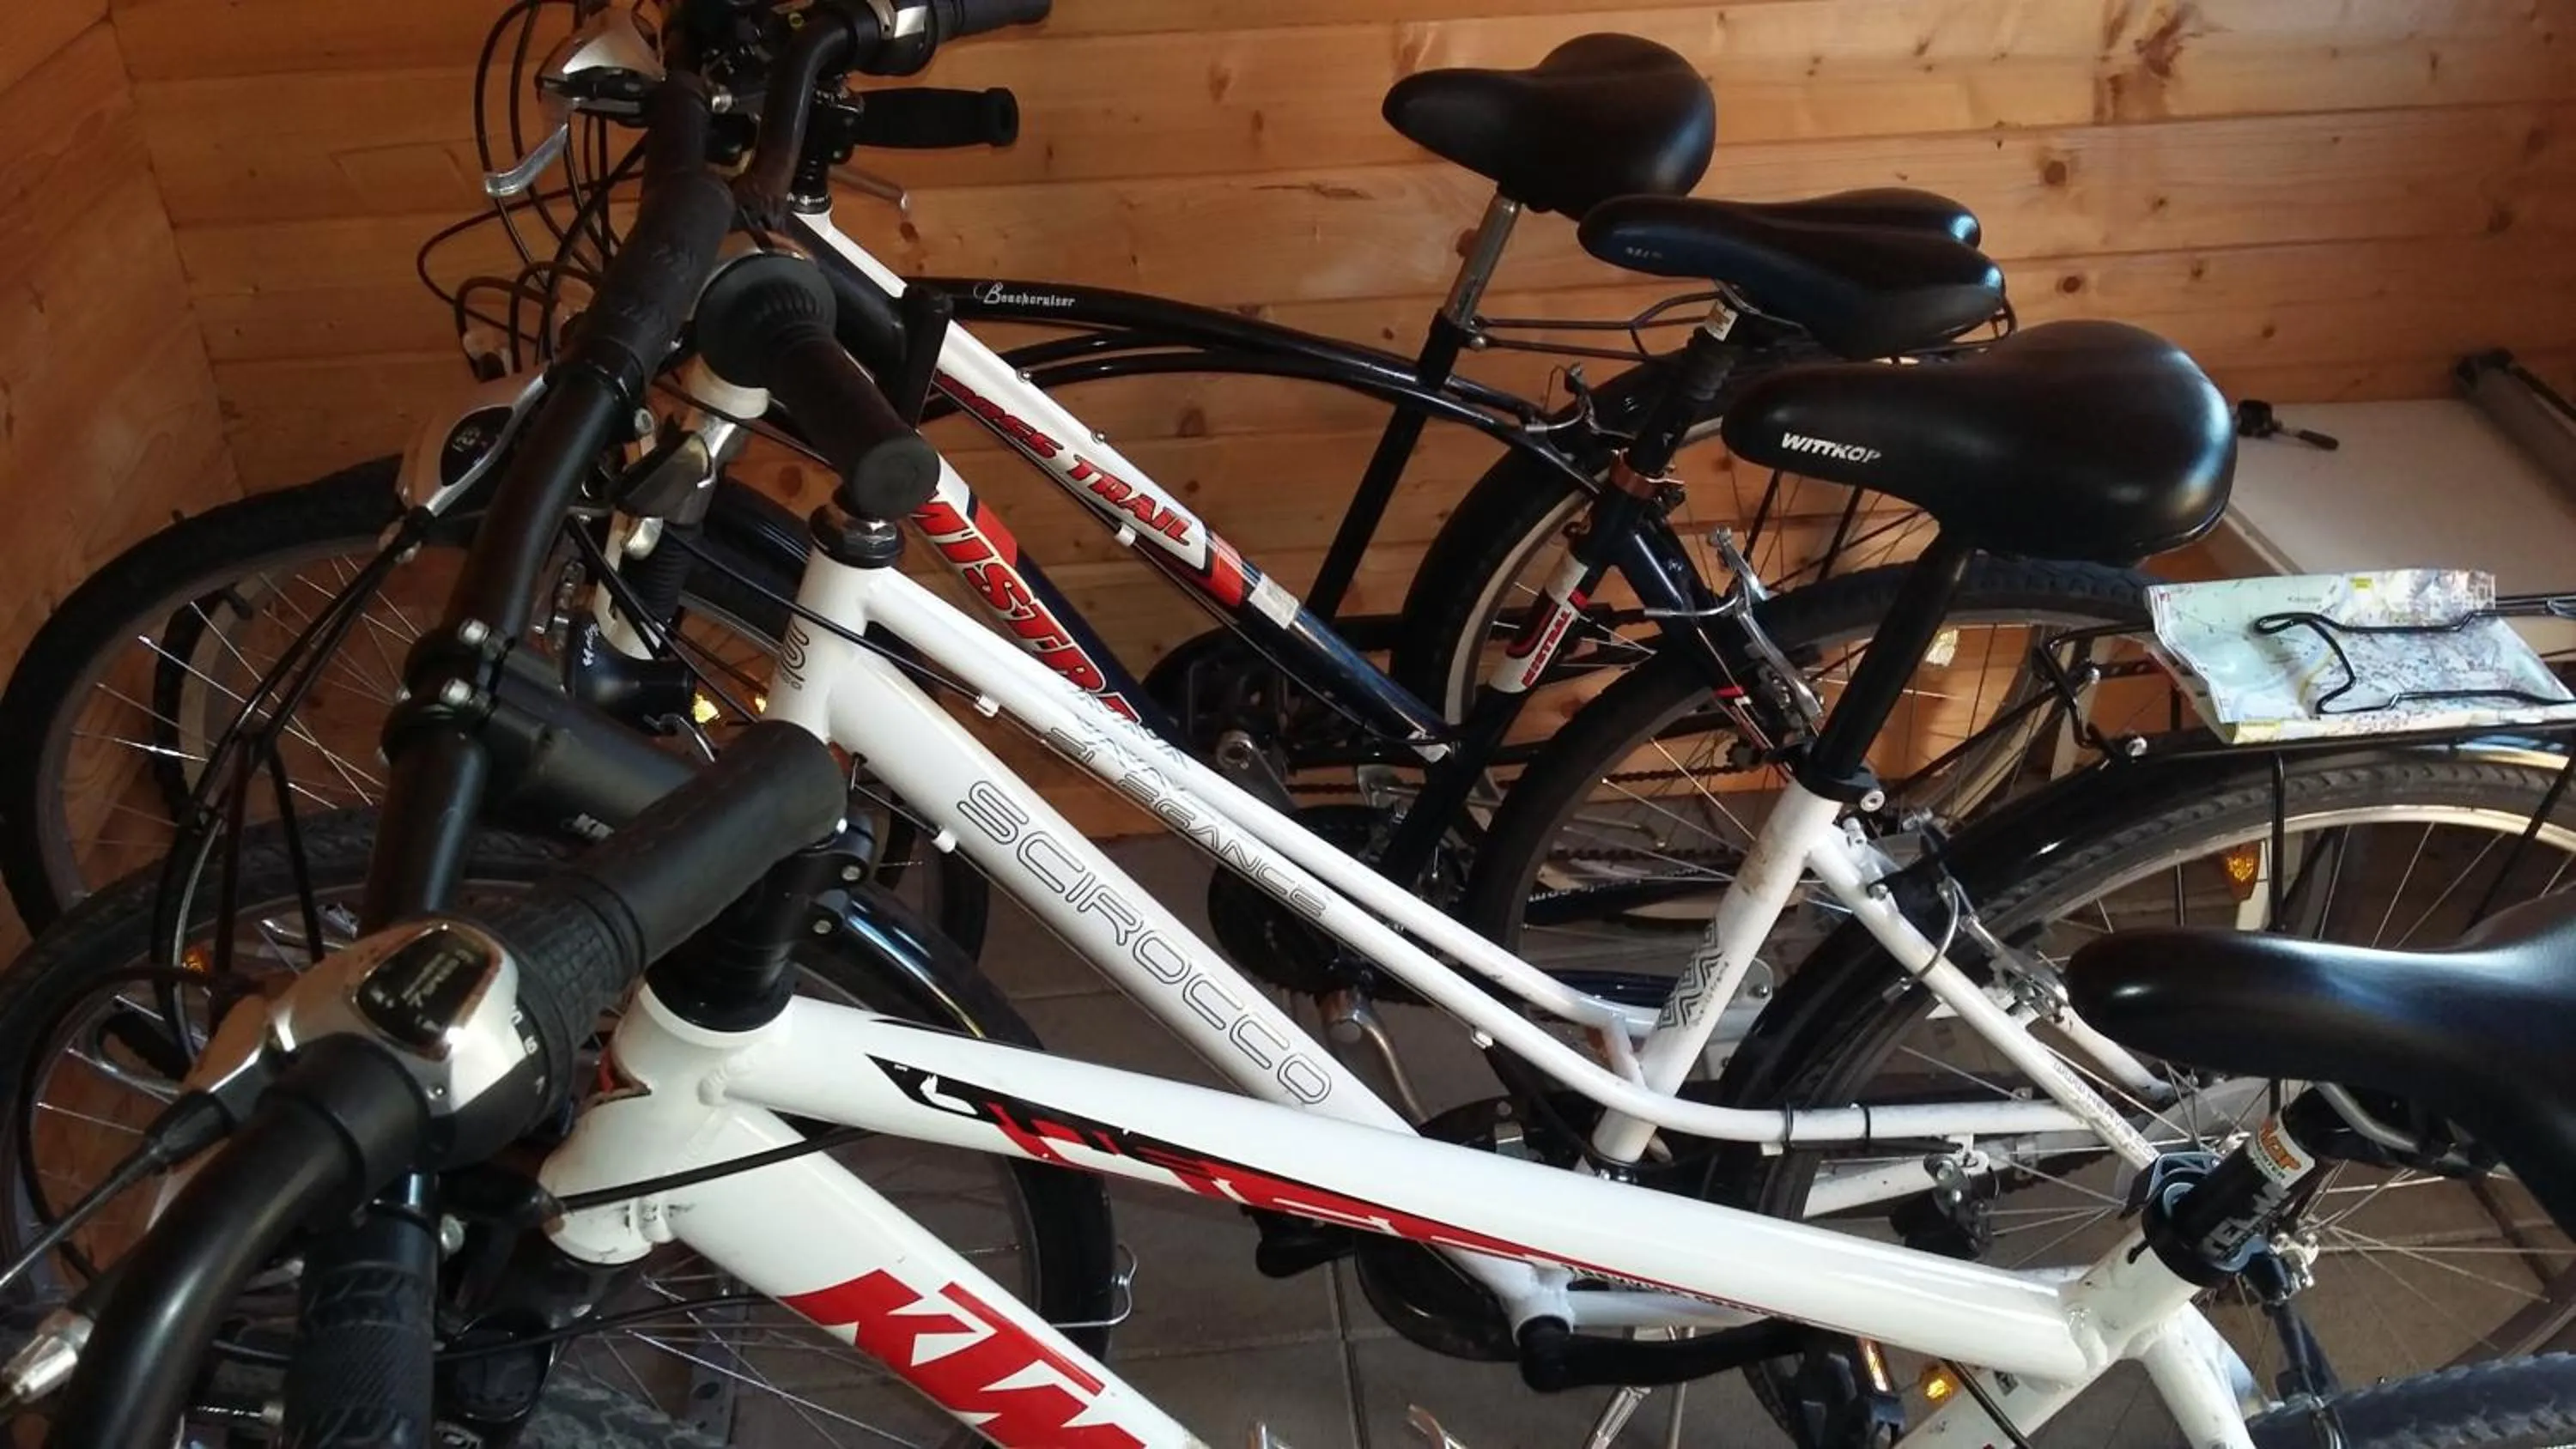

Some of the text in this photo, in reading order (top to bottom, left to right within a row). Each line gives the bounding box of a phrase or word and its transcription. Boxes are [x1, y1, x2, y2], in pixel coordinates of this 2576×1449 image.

[973, 282, 1076, 307] Beachcruiser
[1782, 432, 1882, 463] WITTKOP
[1066, 453, 1190, 547] TRAIL
[957, 780, 1333, 1105] SCIROCCO
